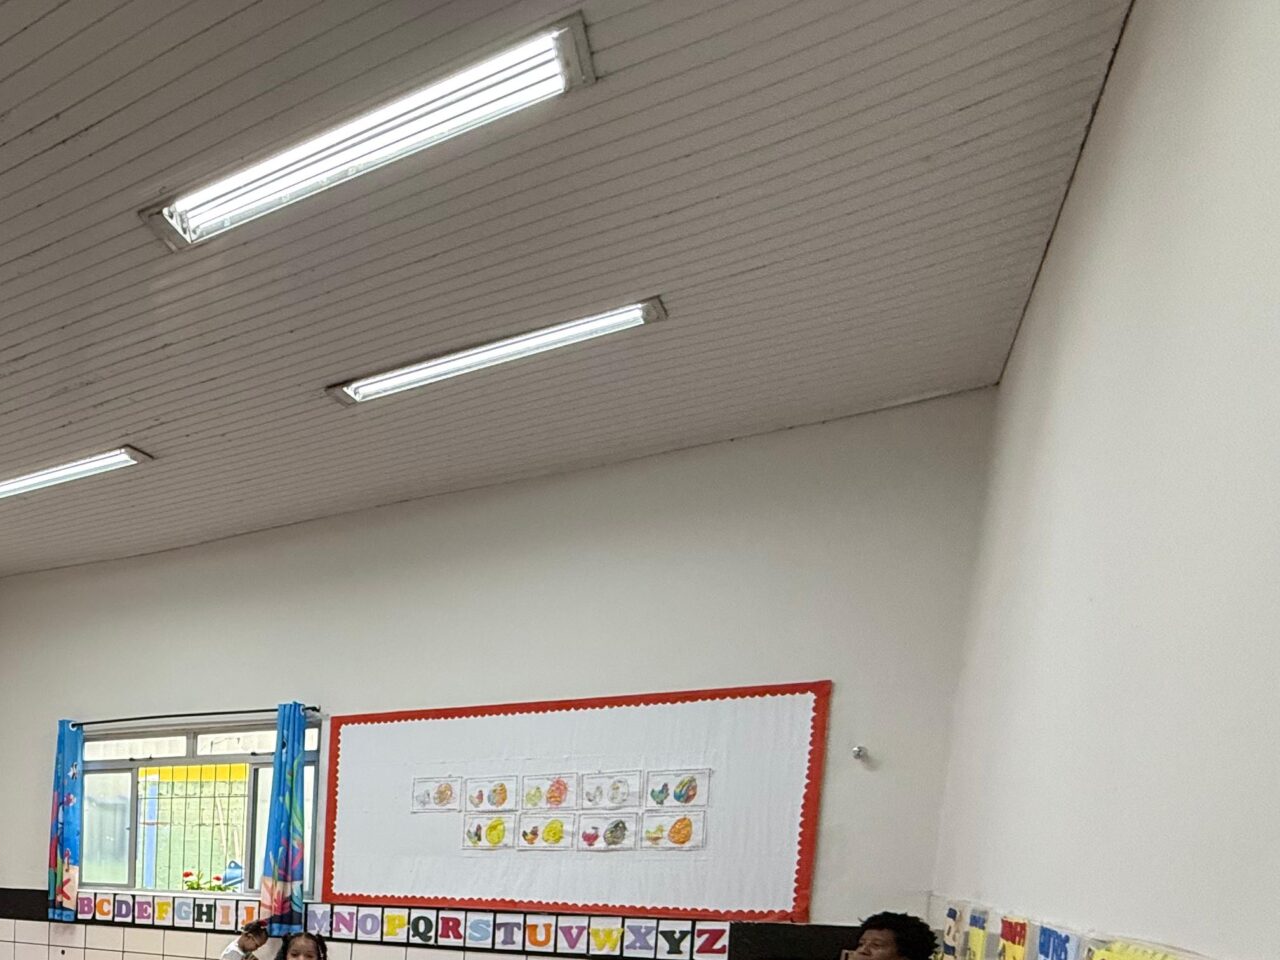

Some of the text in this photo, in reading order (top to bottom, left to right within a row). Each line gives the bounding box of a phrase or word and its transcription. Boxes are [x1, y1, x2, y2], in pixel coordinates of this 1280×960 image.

[78, 896, 255, 924] B C D E F G H I J
[308, 910, 727, 954] M N O P Q R S T U V W X Y Z
